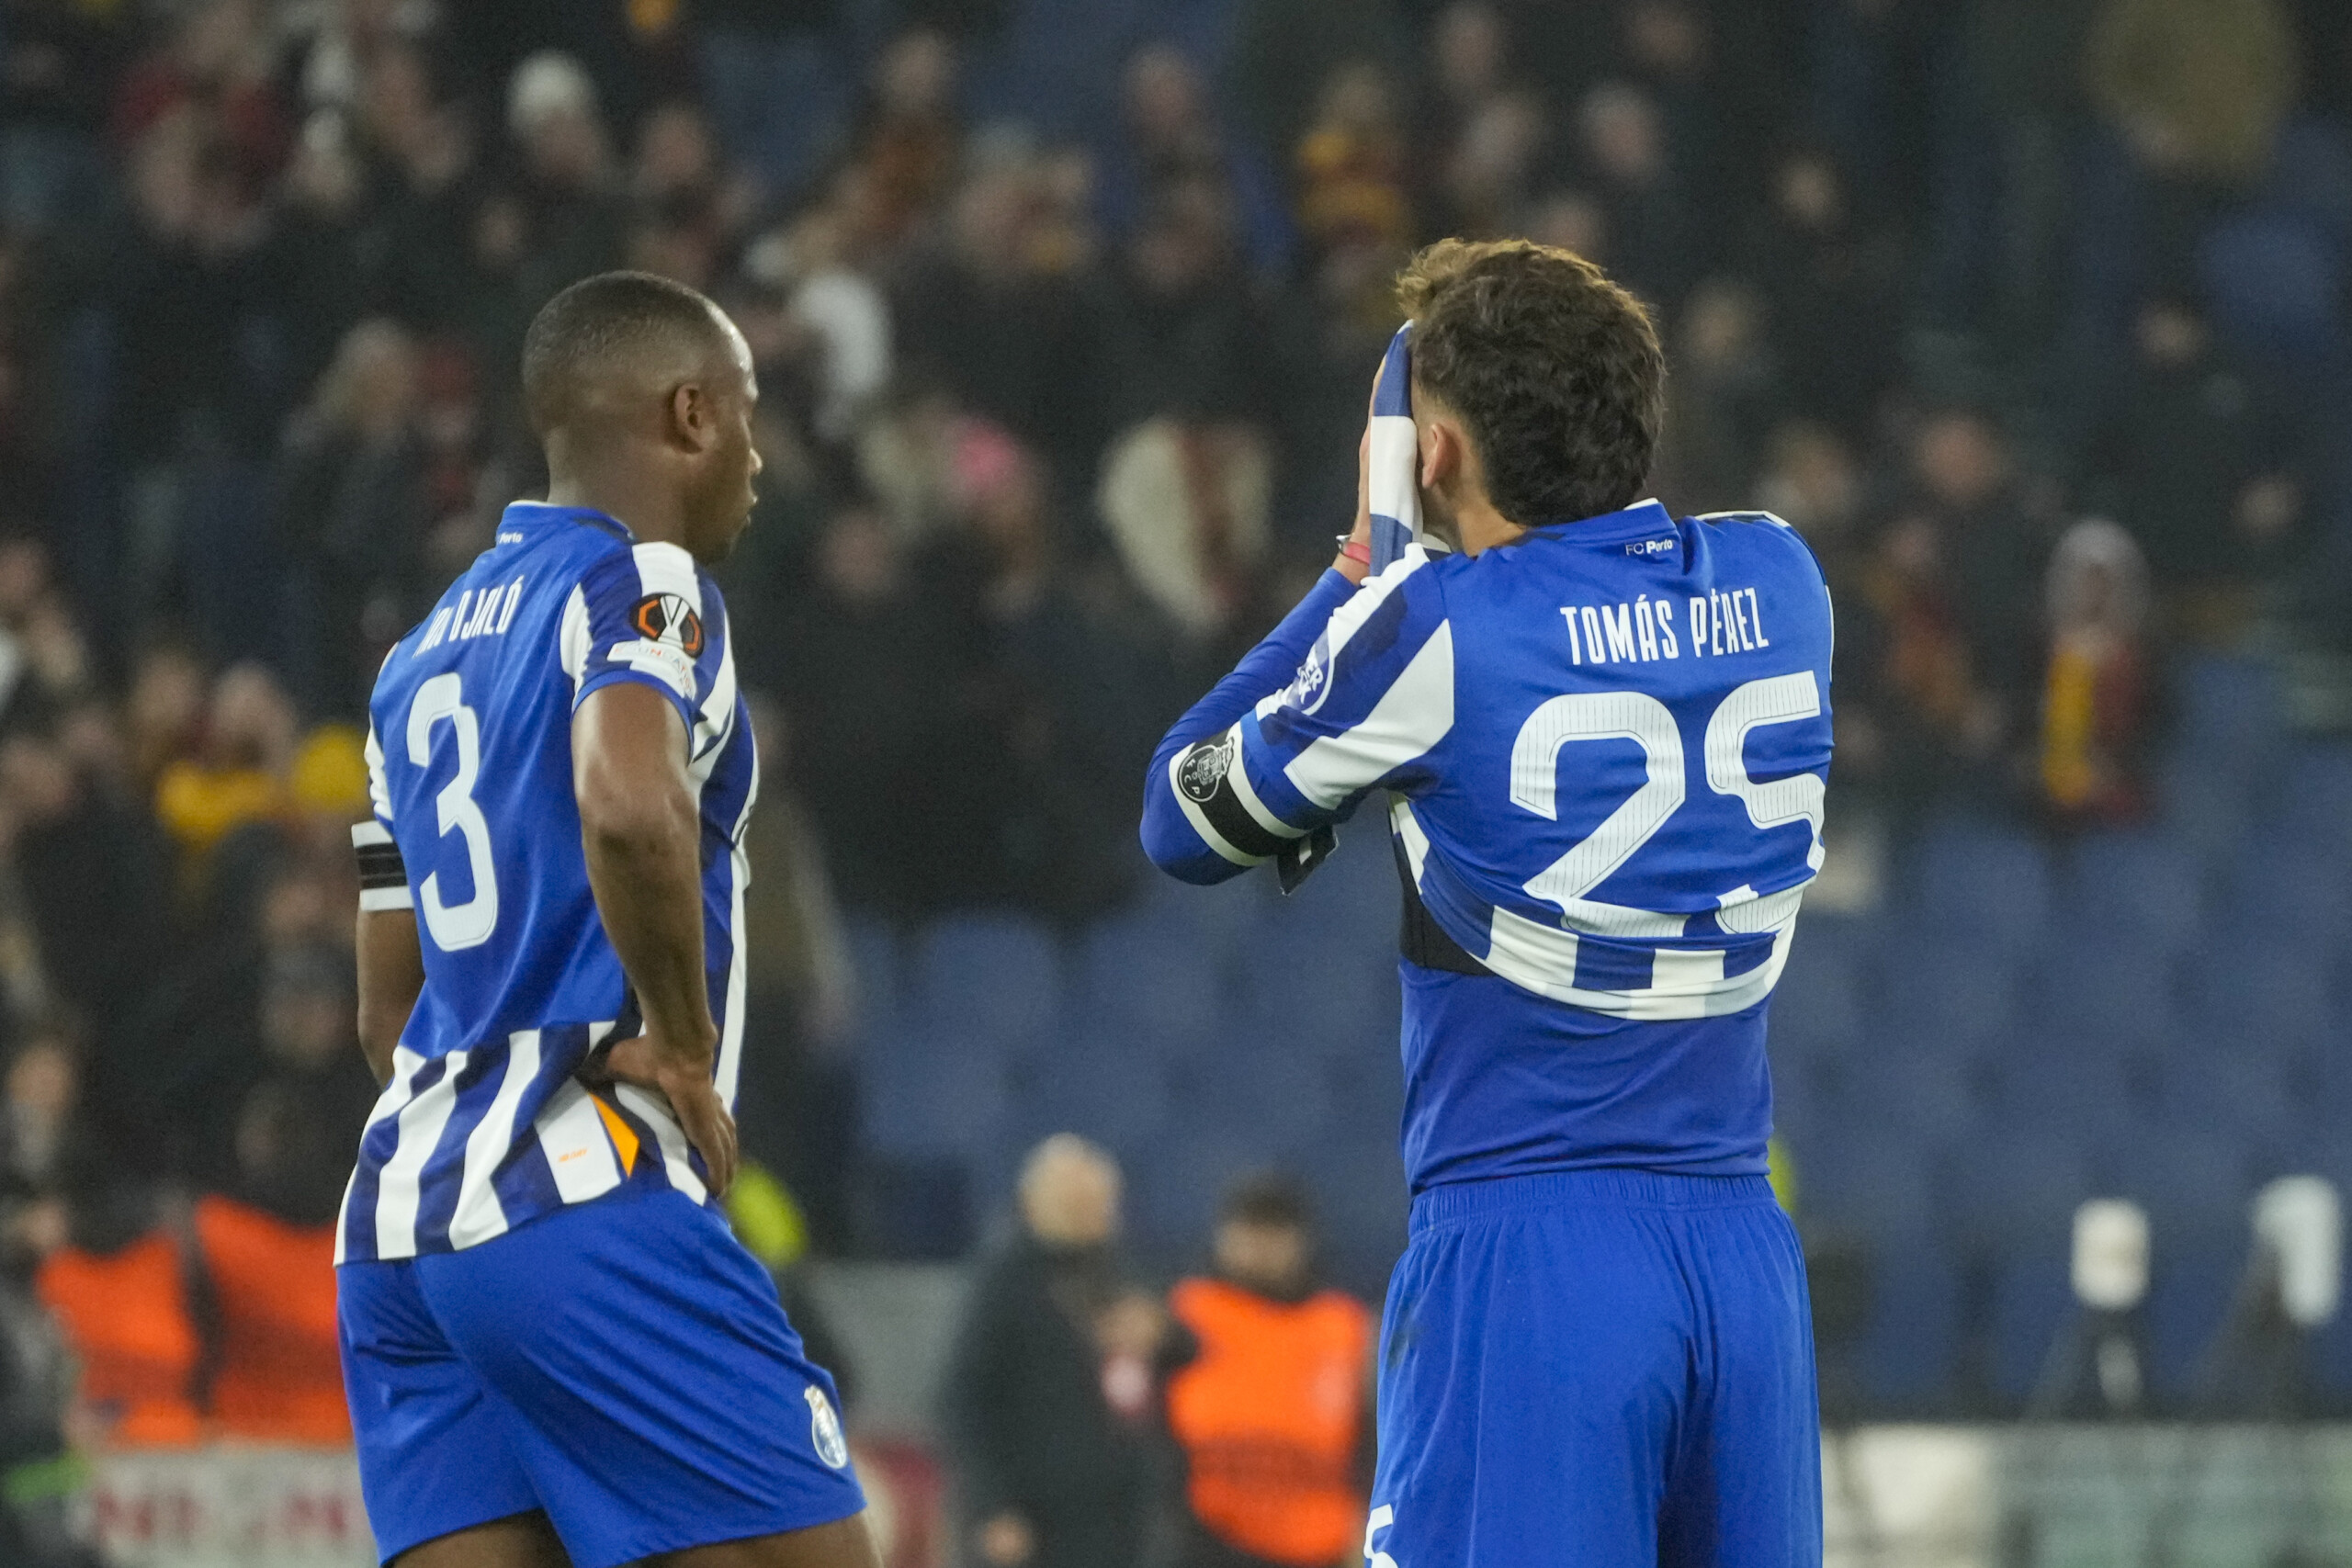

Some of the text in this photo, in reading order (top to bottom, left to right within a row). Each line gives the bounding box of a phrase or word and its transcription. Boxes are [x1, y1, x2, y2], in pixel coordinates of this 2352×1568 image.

[1560, 587, 1770, 665] TOMÁS PÉREZ
[1625, 538, 1673, 556] FC Porto
[406, 671, 498, 952] 3
[1510, 670, 1826, 938] 25
